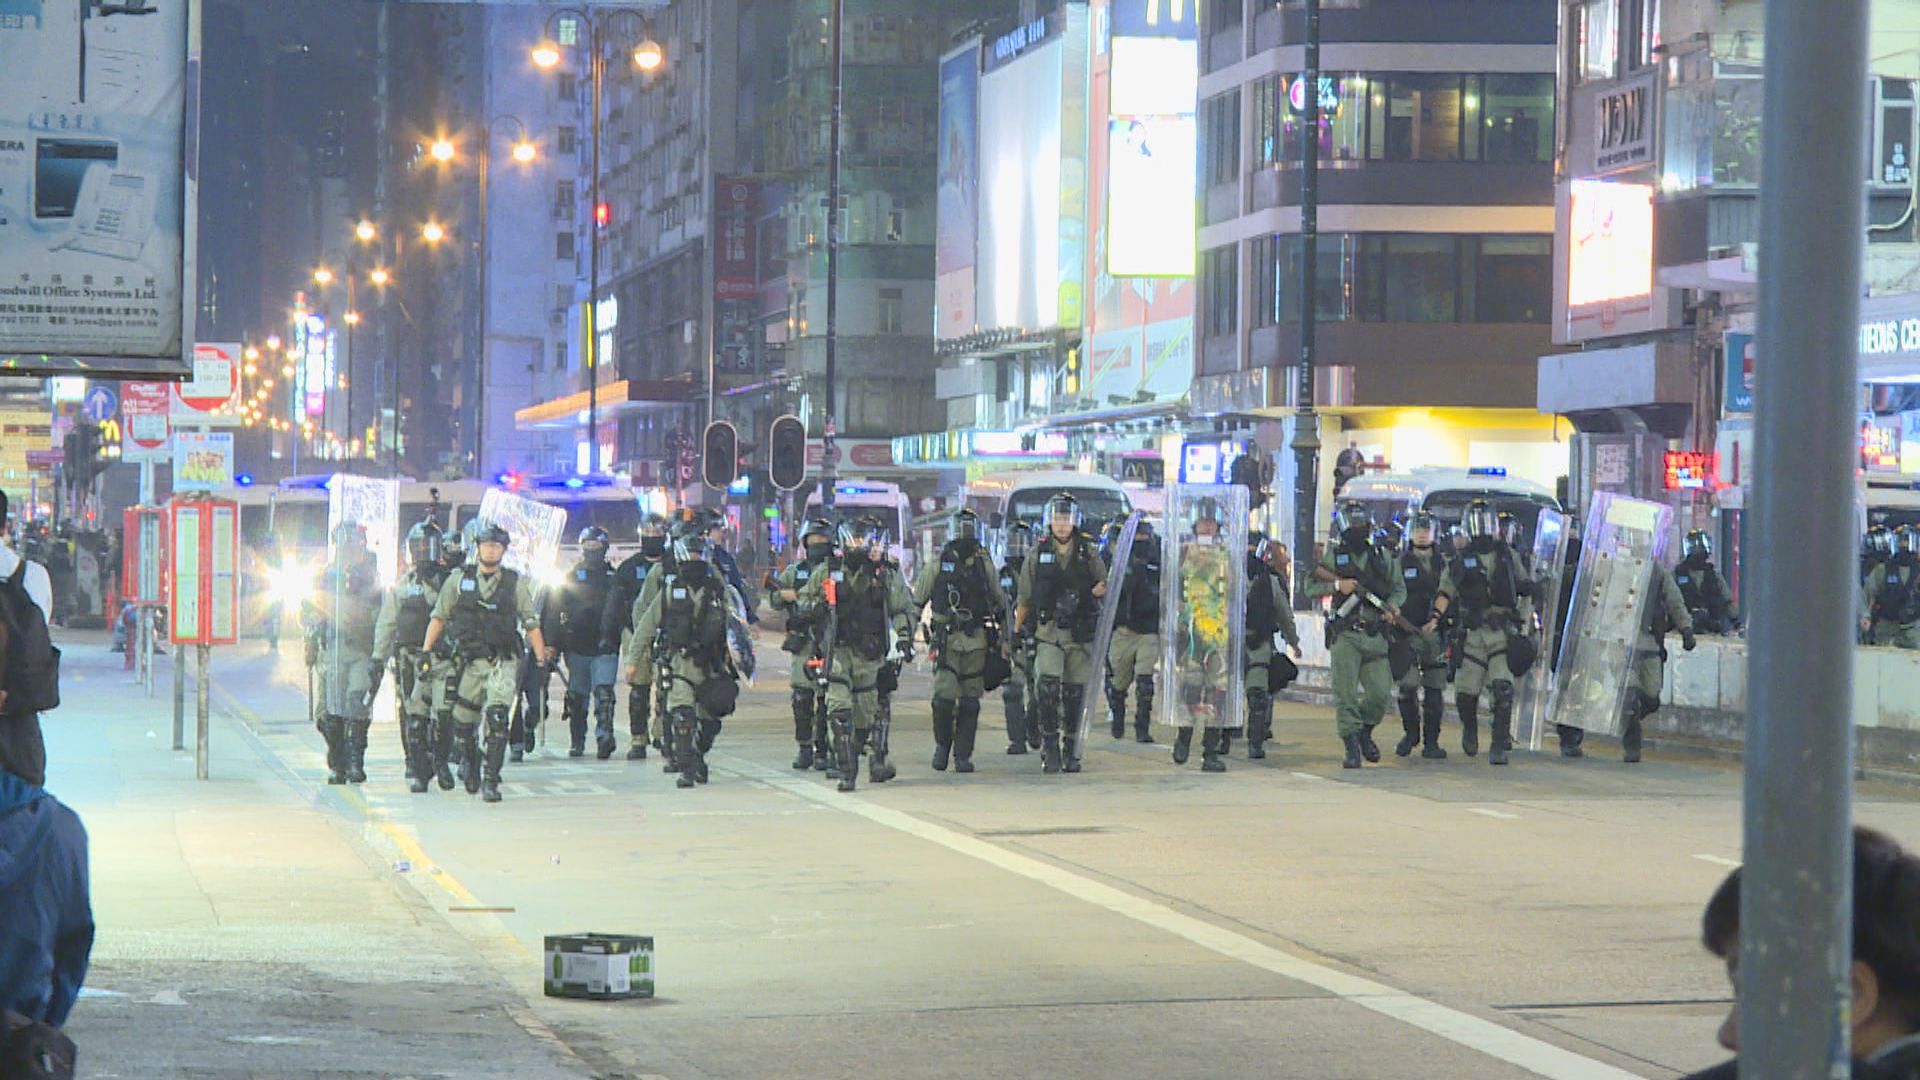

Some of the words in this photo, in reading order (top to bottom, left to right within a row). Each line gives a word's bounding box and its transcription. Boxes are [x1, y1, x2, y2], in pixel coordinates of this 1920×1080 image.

[43, 286, 79, 297] Office
[83, 287, 132, 300] Systems
[135, 287, 159, 299] Ltd.
